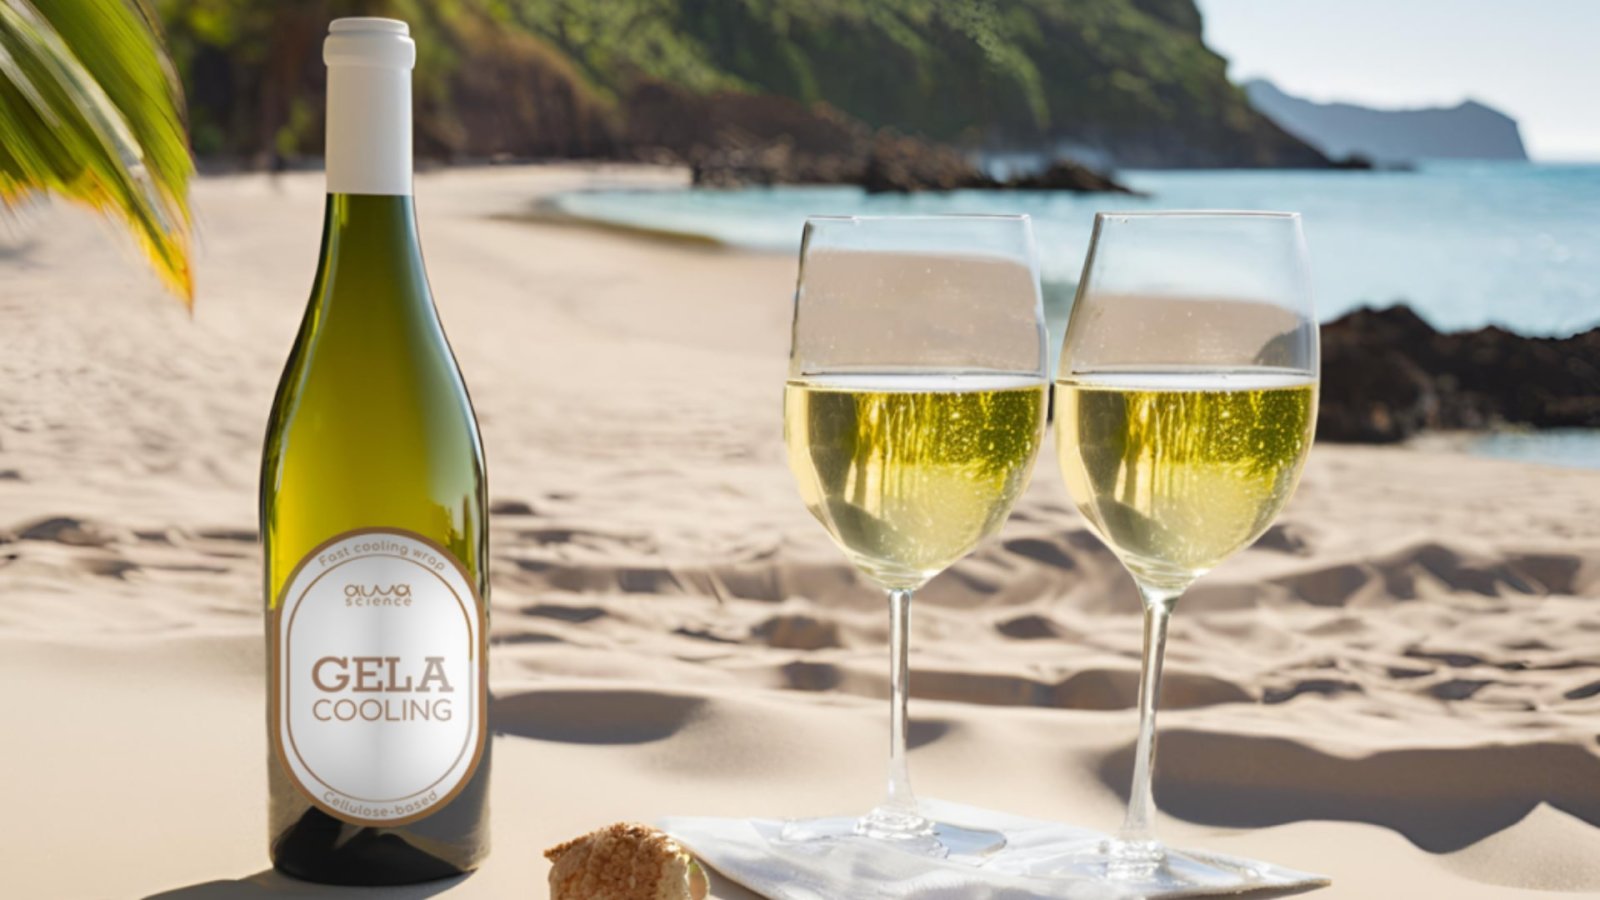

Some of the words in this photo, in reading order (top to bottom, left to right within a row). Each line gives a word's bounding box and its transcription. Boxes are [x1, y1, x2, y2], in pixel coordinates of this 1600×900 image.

[318, 547, 350, 567] Fast
[353, 540, 409, 555] cooling
[412, 548, 446, 571] wrap
[345, 597, 412, 607] science
[311, 656, 454, 693] GELA
[312, 698, 452, 721] COOLING
[323, 790, 438, 817] Cellulose-based
